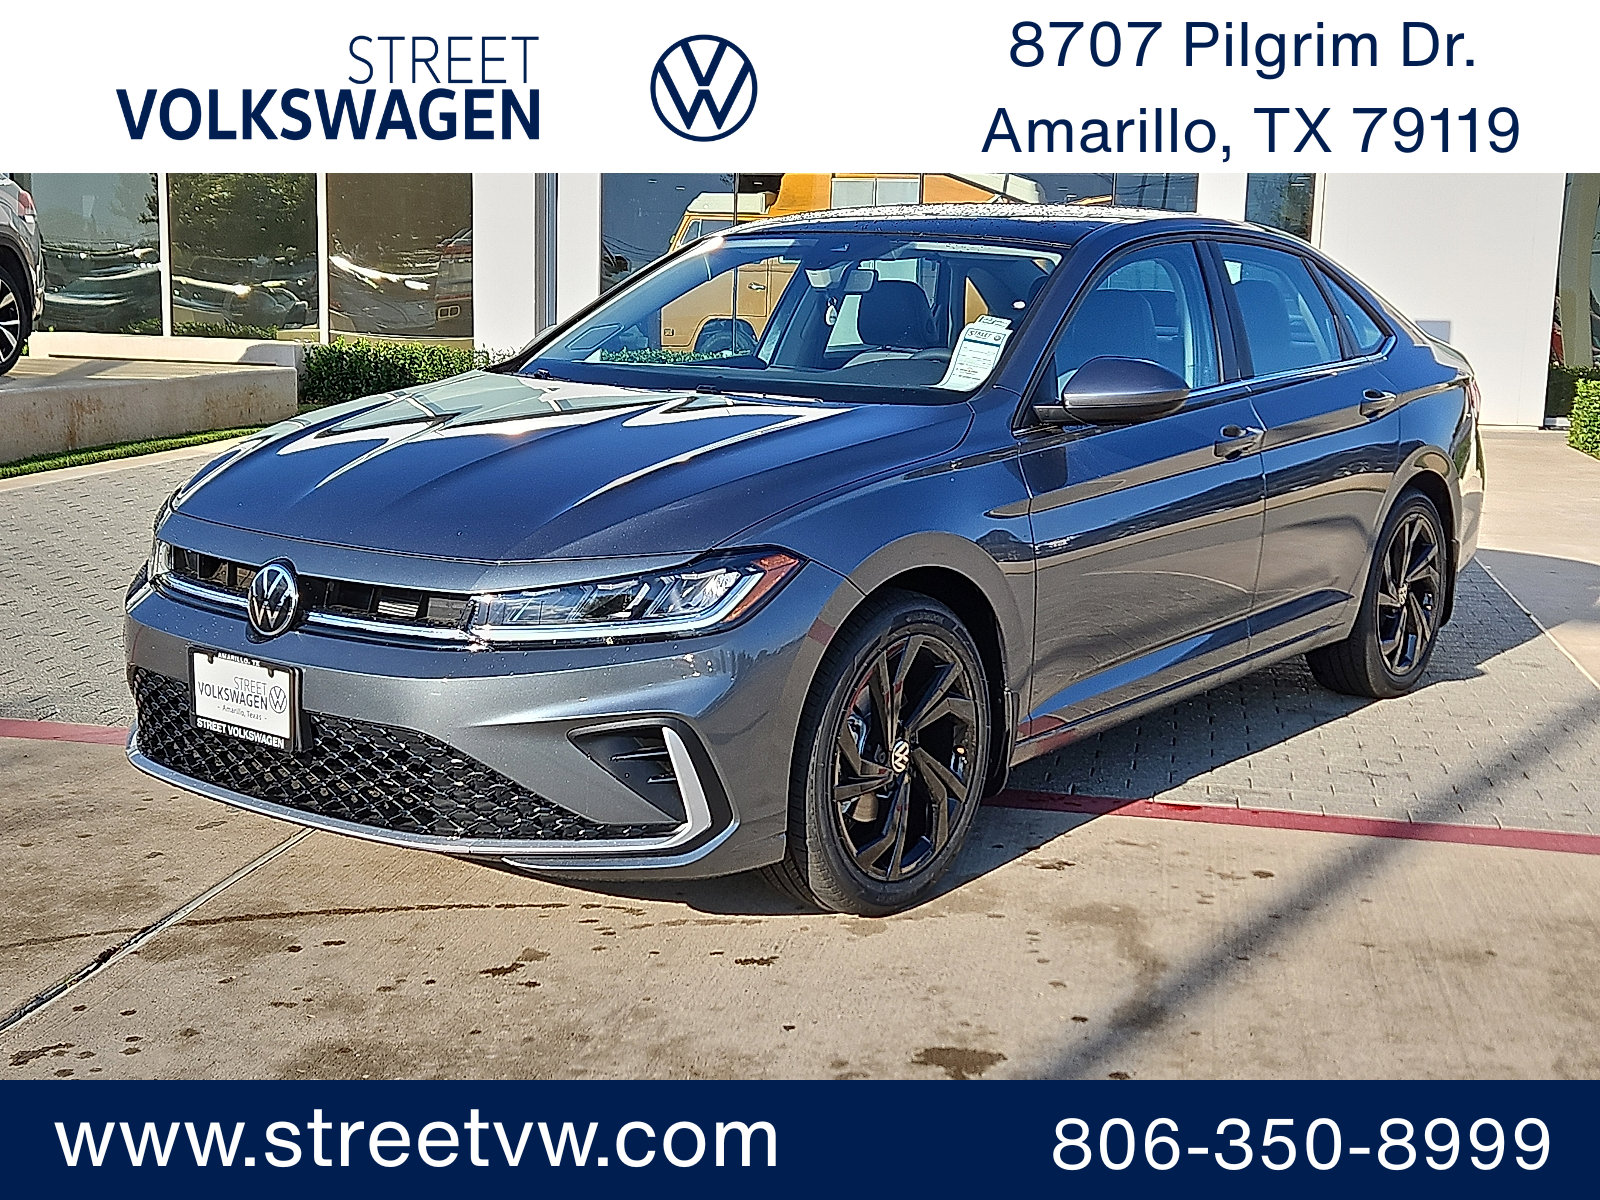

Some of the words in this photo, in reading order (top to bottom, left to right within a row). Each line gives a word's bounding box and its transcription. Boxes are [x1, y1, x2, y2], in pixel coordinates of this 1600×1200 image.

[198, 681, 268, 710] VOLKSWAGEN
[233, 676, 267, 696] STREET
[247, 710, 262, 721] Texas
[197, 718, 227, 734] STREET
[227, 725, 285, 750] VOLKSWAGEN
